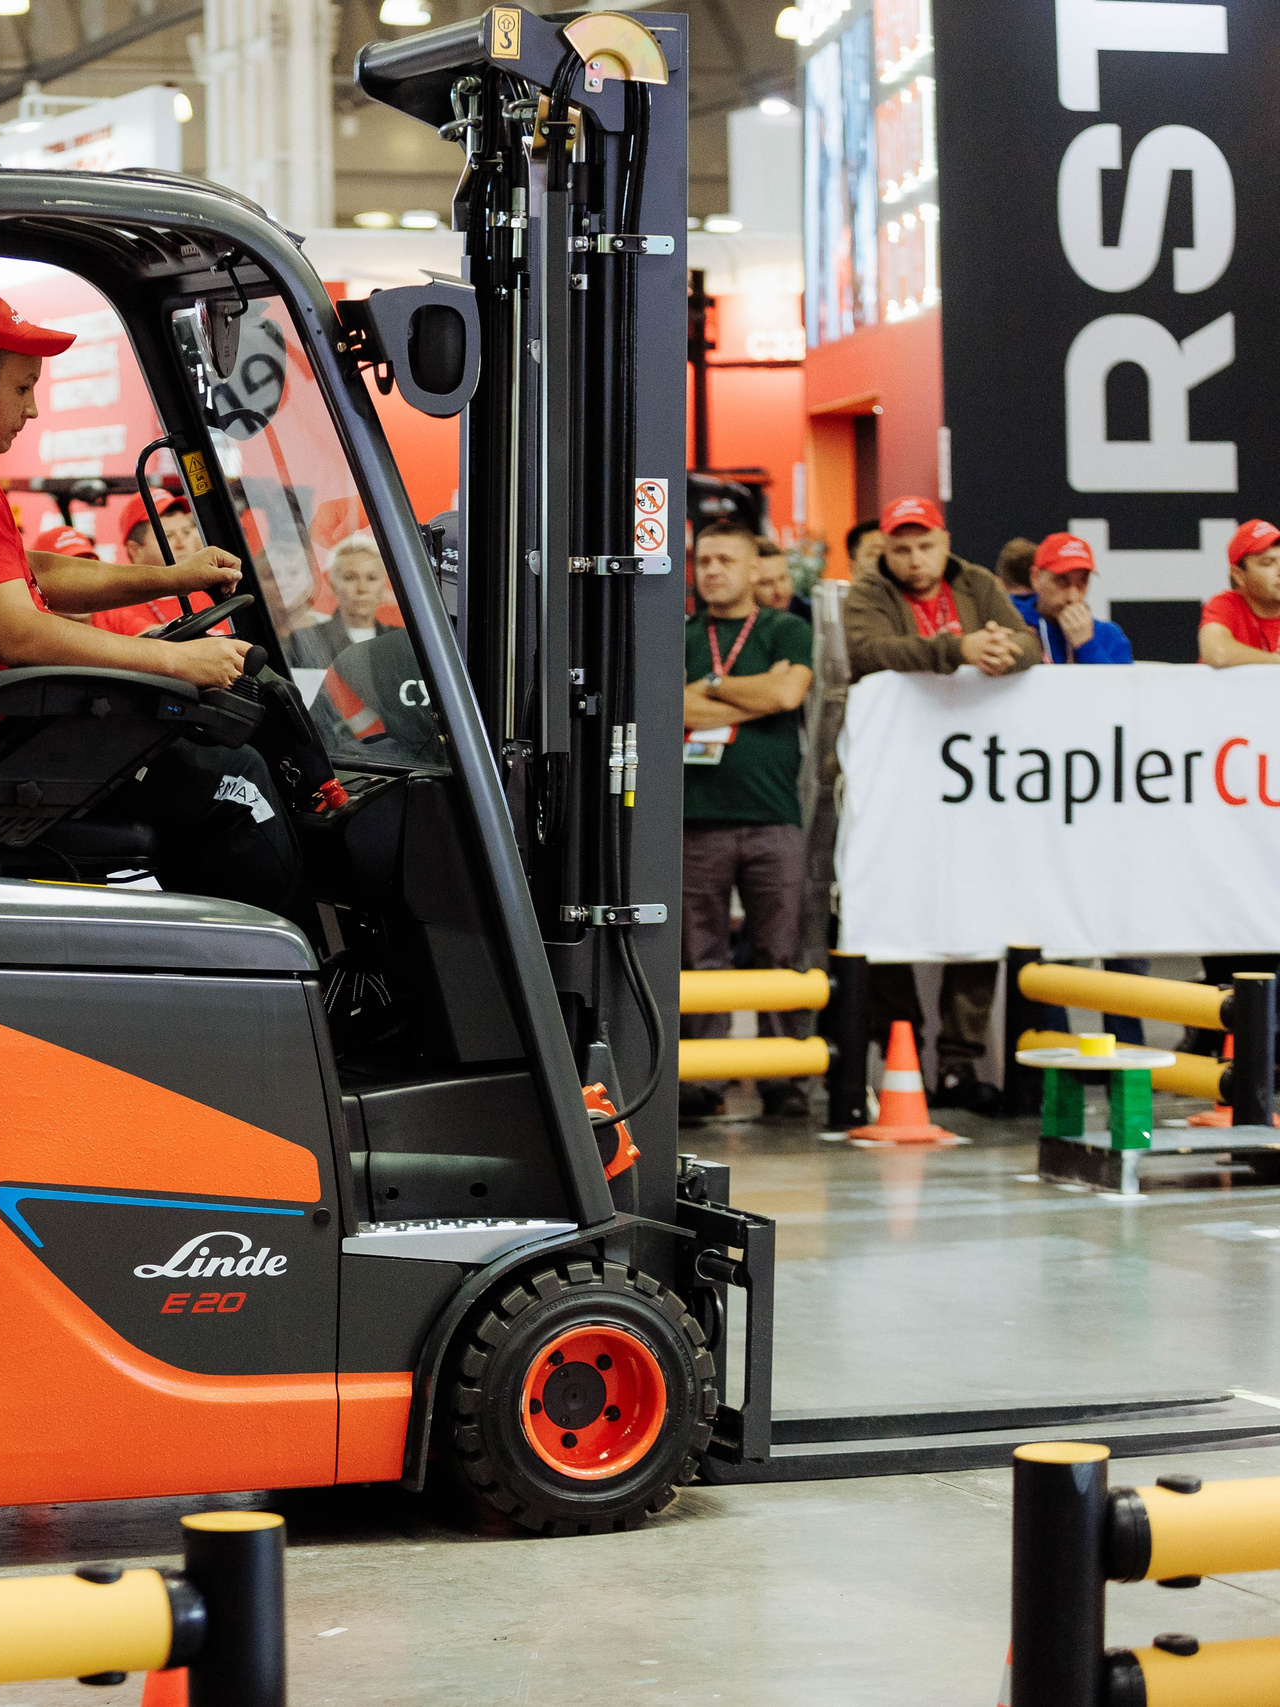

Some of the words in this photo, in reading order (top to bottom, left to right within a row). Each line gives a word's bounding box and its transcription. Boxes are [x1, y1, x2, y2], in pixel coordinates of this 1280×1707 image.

[133, 1230, 288, 1279] Linde
[160, 1292, 191, 1314] E
[190, 1292, 247, 1314] 20
